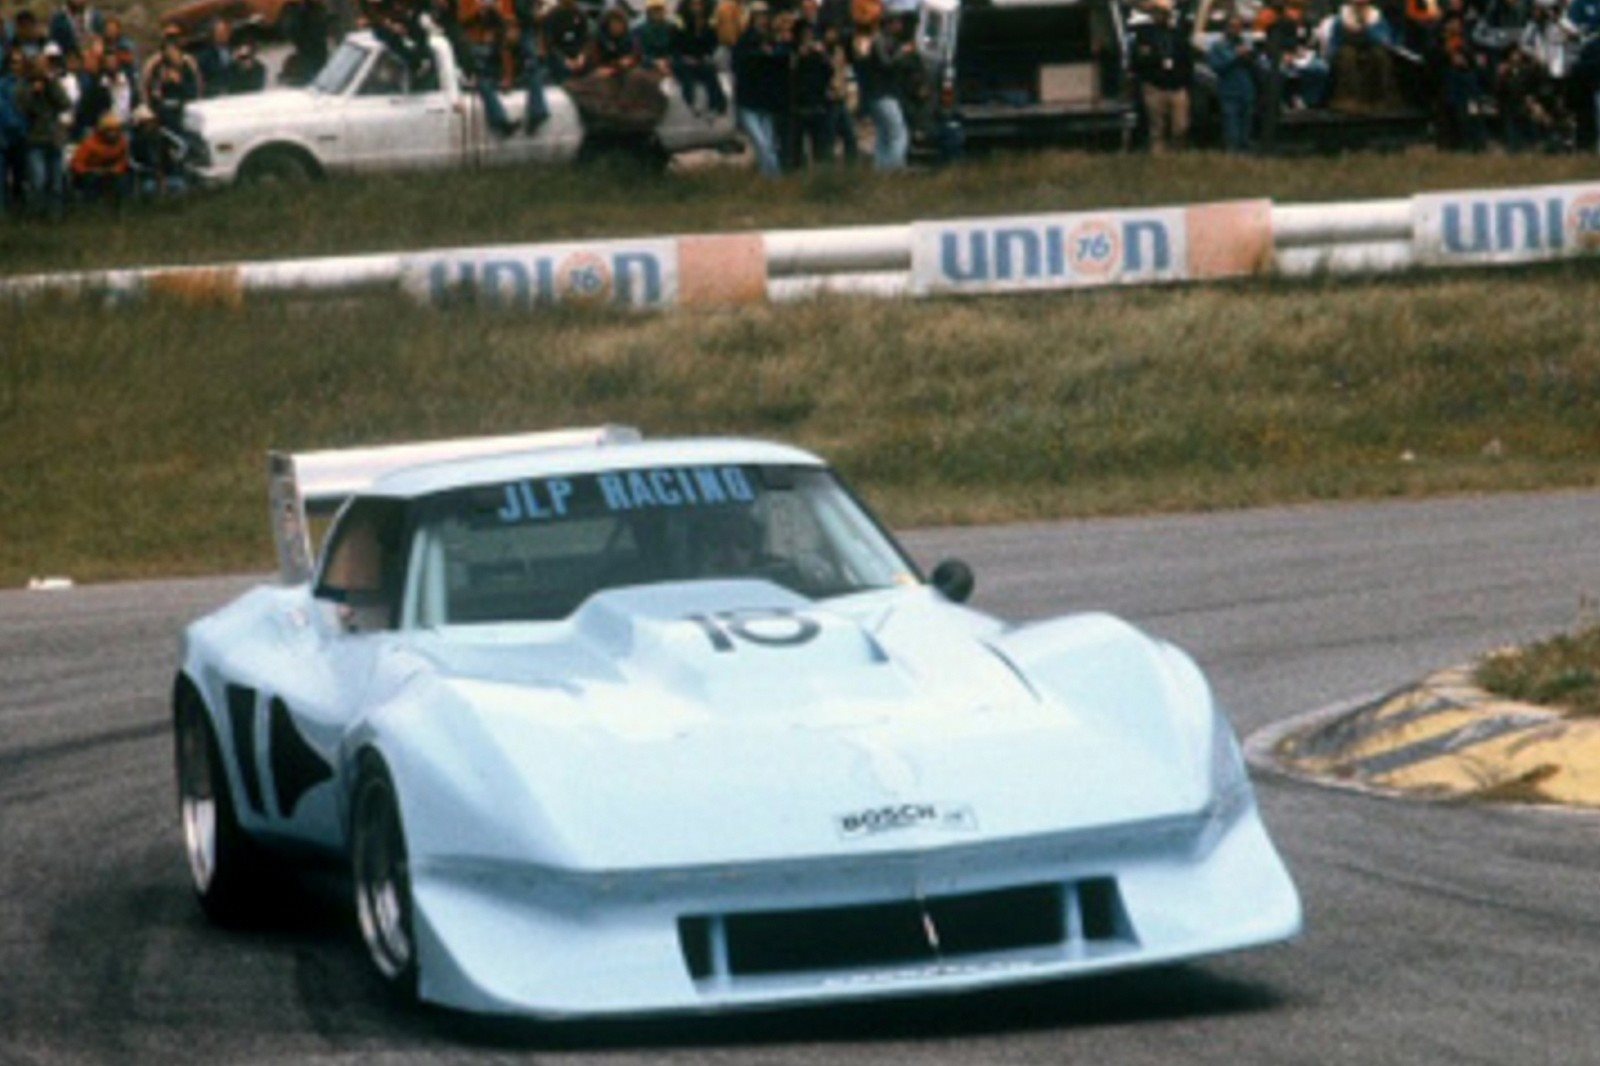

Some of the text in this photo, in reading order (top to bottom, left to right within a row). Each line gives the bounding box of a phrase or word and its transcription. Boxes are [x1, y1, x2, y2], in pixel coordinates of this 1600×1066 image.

[1076, 233, 1110, 259] 76
[497, 467, 755, 524] JLP RACING
